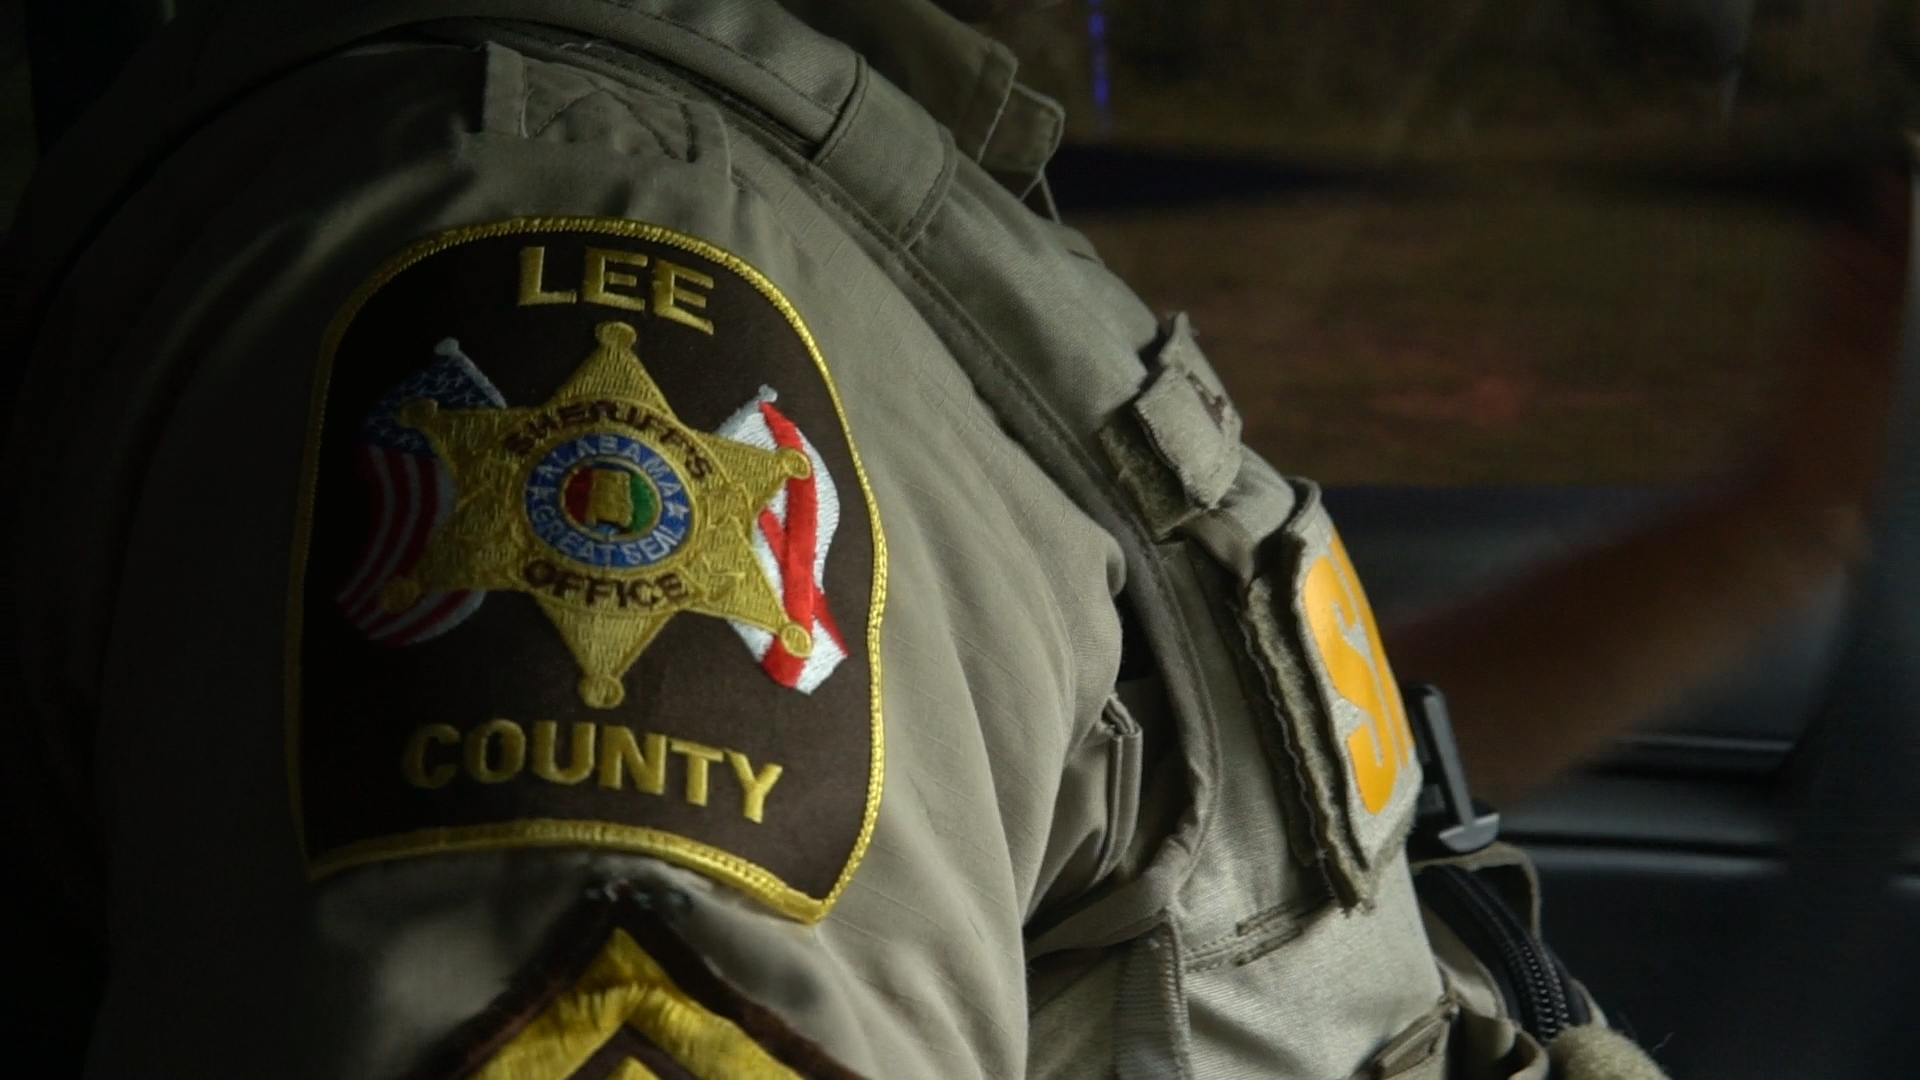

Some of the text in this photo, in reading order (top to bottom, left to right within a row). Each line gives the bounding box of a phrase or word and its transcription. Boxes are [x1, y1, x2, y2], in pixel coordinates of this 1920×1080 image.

[517, 245, 715, 336] LEE
[506, 402, 712, 479] SHERIFF'S
[536, 434, 682, 497] ALABAMA
[532, 505, 686, 567] GREAT SEAL
[525, 560, 689, 606] OFFICE
[403, 718, 783, 824] COUNTY
